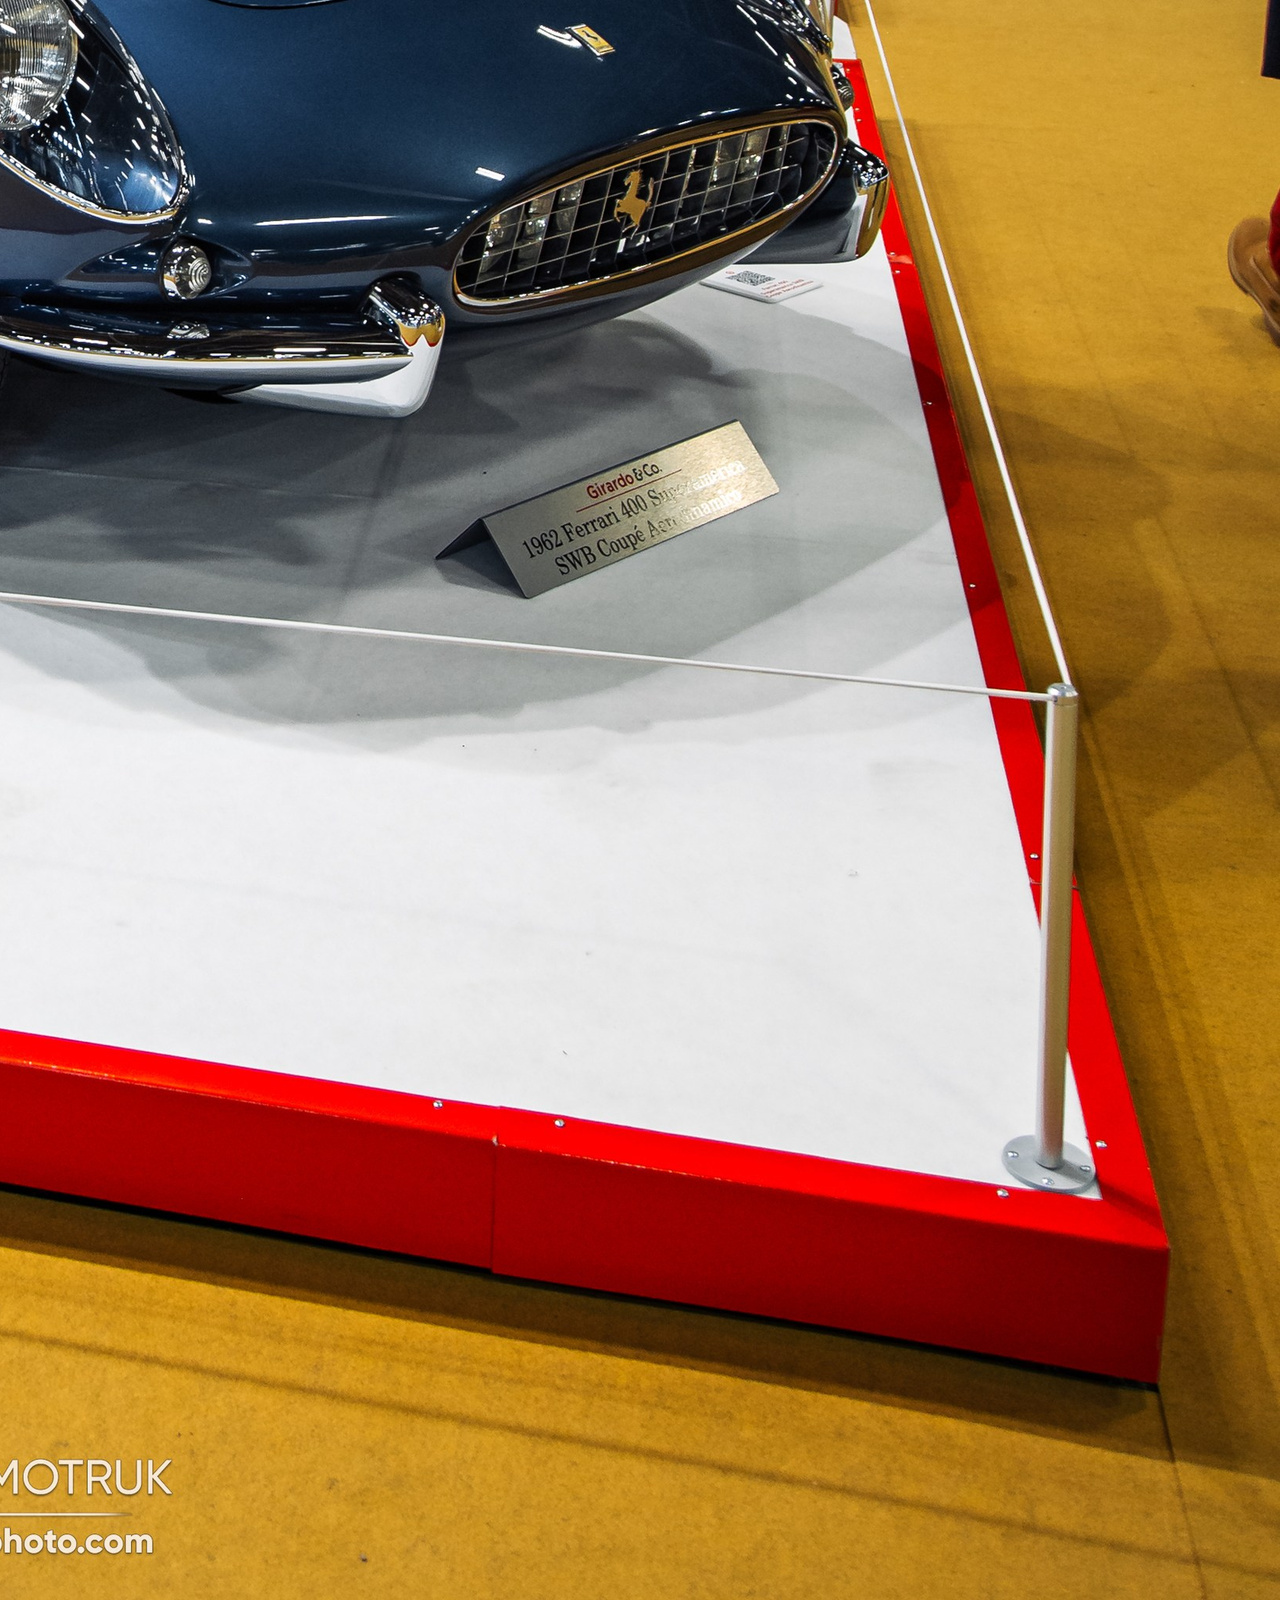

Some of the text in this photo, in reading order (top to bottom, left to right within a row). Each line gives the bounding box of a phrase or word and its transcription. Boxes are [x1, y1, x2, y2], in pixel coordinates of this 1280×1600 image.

[522, 529, 564, 559] 1962
[561, 506, 621, 543] Ferrari
[621, 494, 648, 519] 400
[554, 544, 597, 576] SWB
[596, 524, 646, 558] Coupé
